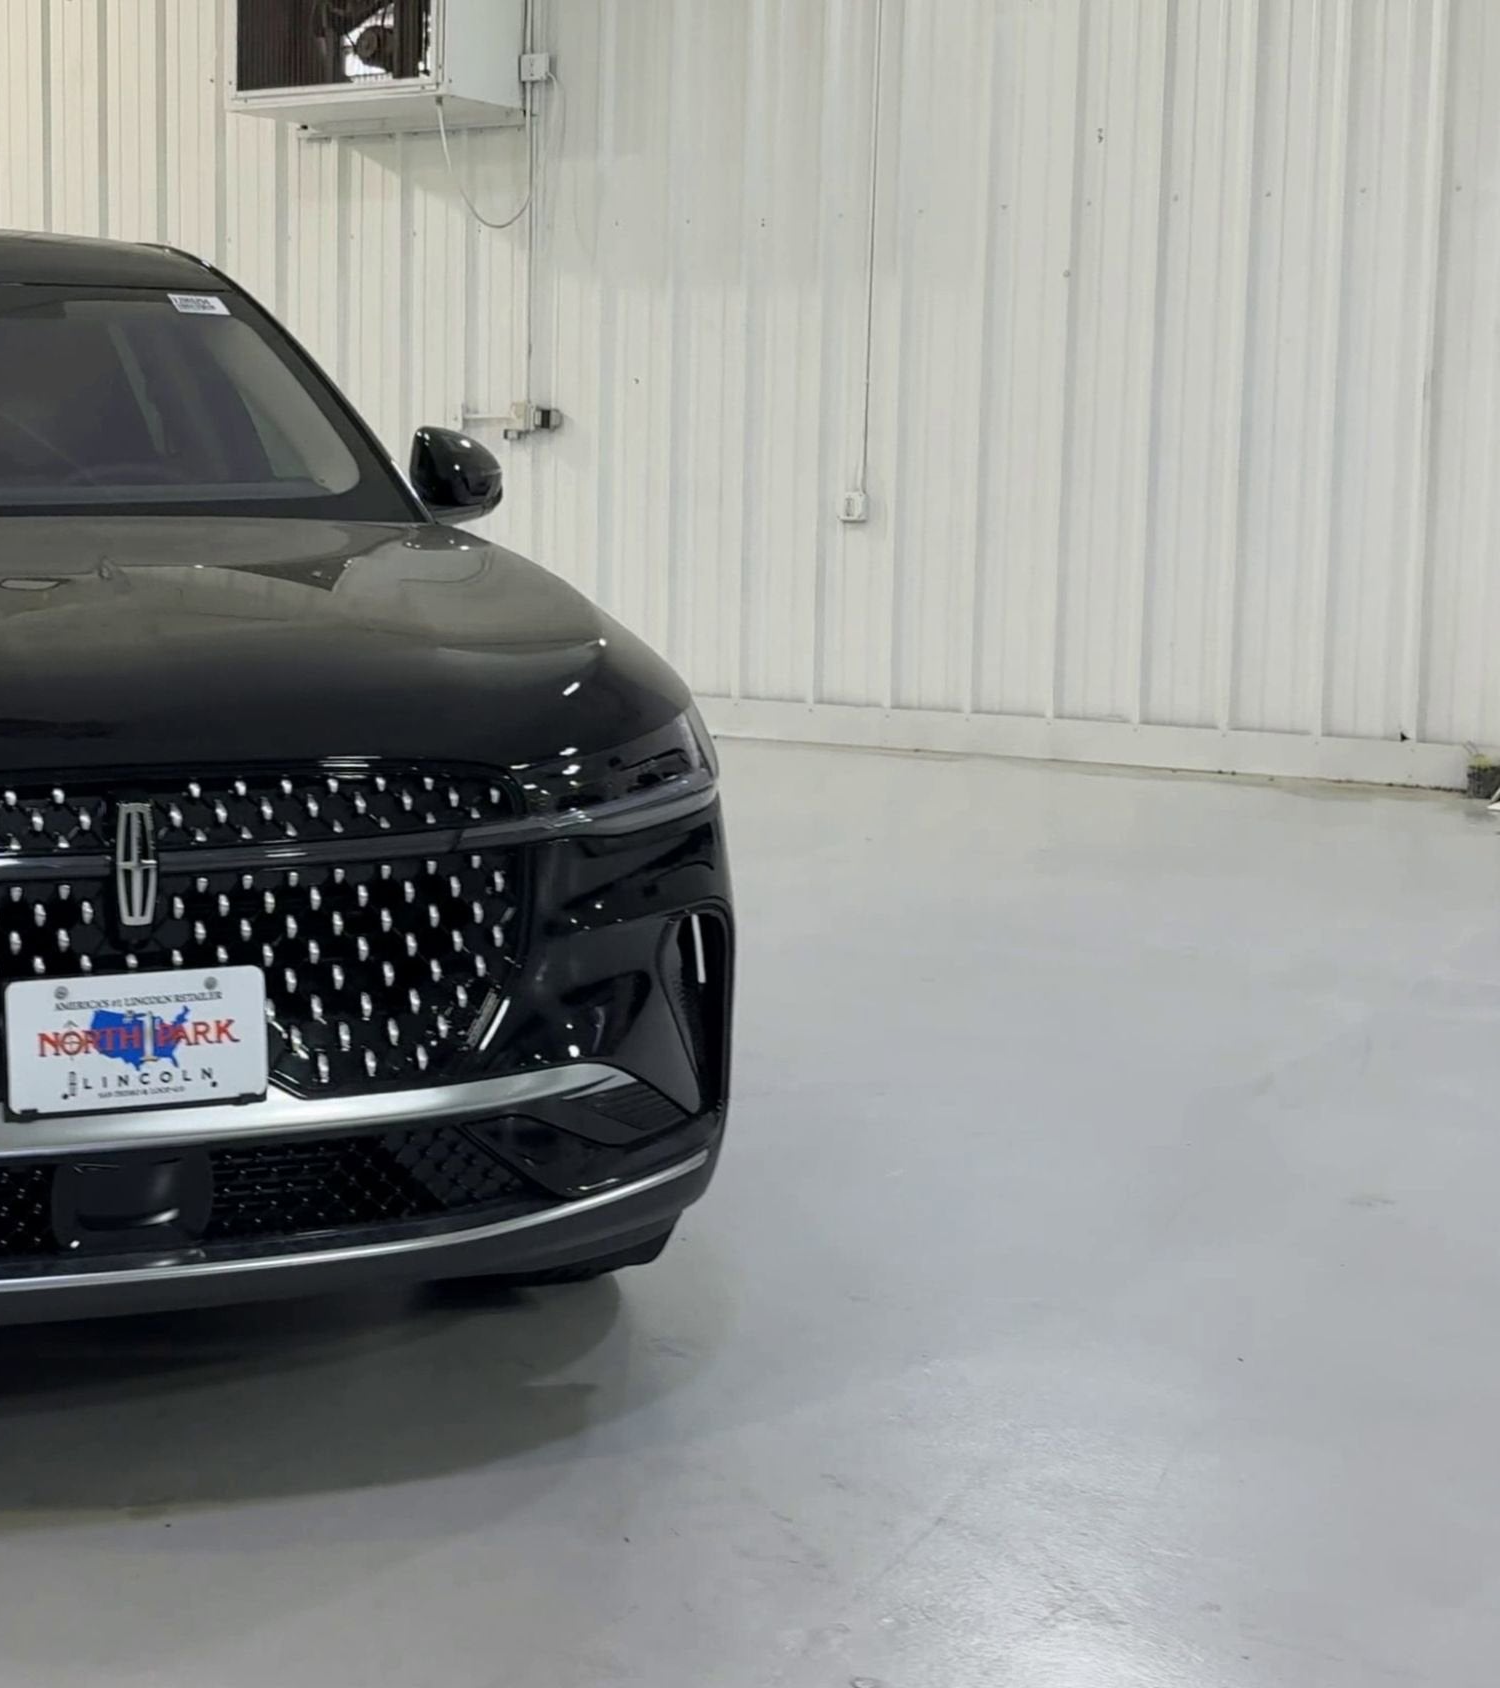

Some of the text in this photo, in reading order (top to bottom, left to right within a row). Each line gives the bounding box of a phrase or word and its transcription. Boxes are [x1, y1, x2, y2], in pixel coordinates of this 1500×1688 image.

[124, 994, 172, 1007] LINCOLN
[174, 991, 223, 1003] RETAILER
[38, 1018, 241, 1058] NORTH PARK
[82, 1067, 213, 1089] LINCOLN
